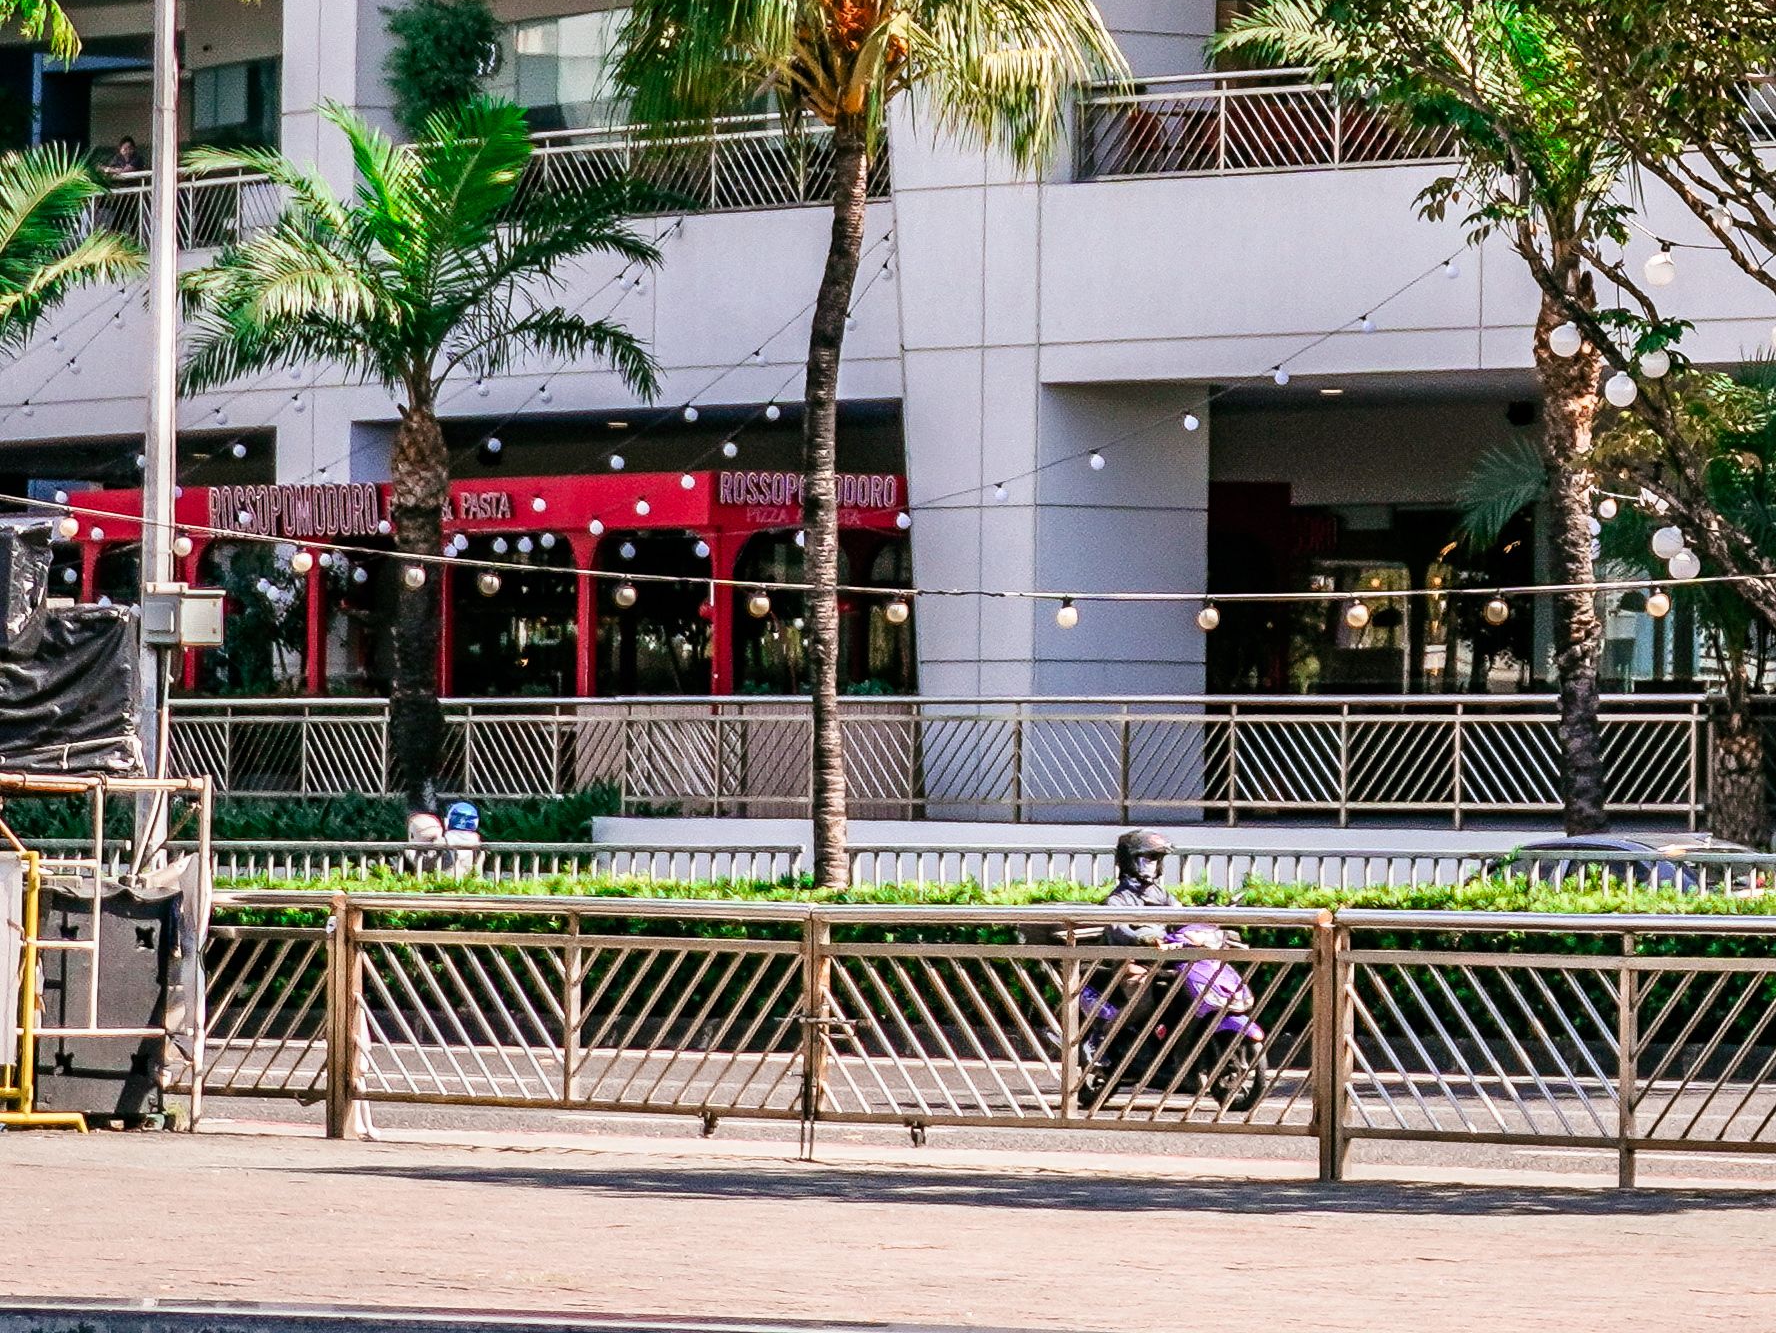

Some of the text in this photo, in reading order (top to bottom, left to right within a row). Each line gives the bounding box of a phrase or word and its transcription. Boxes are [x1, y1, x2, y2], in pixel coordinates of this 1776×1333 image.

[459, 491, 512, 520] PASTA
[719, 471, 897, 507] ROSSOPODORO
[209, 482, 379, 536] ROSSOPOMODORO
